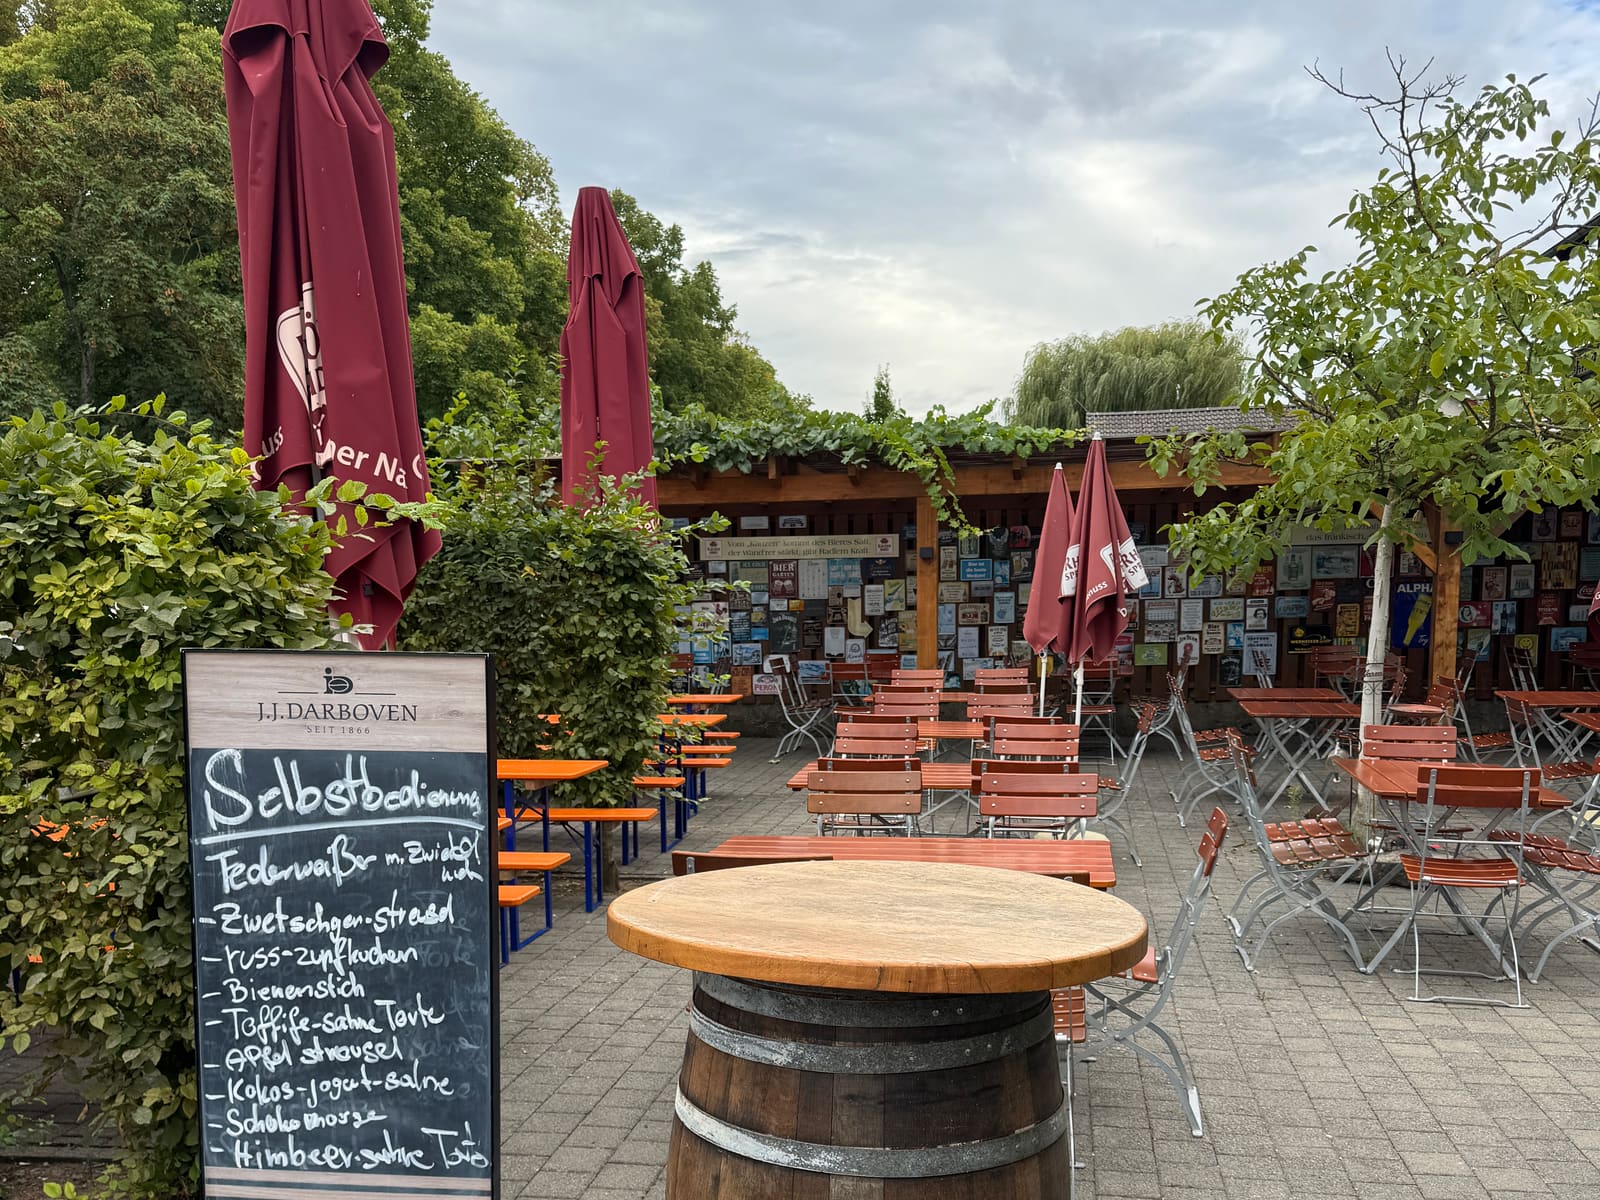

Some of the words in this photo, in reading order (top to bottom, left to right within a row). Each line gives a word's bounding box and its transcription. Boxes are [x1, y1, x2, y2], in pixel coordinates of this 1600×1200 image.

[772, 563, 794, 572] BIER
[257, 702, 418, 722] J.J.DARBOVEN
[306, 725, 335, 734] SEIT
[341, 726, 370, 735] 1866
[204, 748, 482, 831] Selbstbedienung
